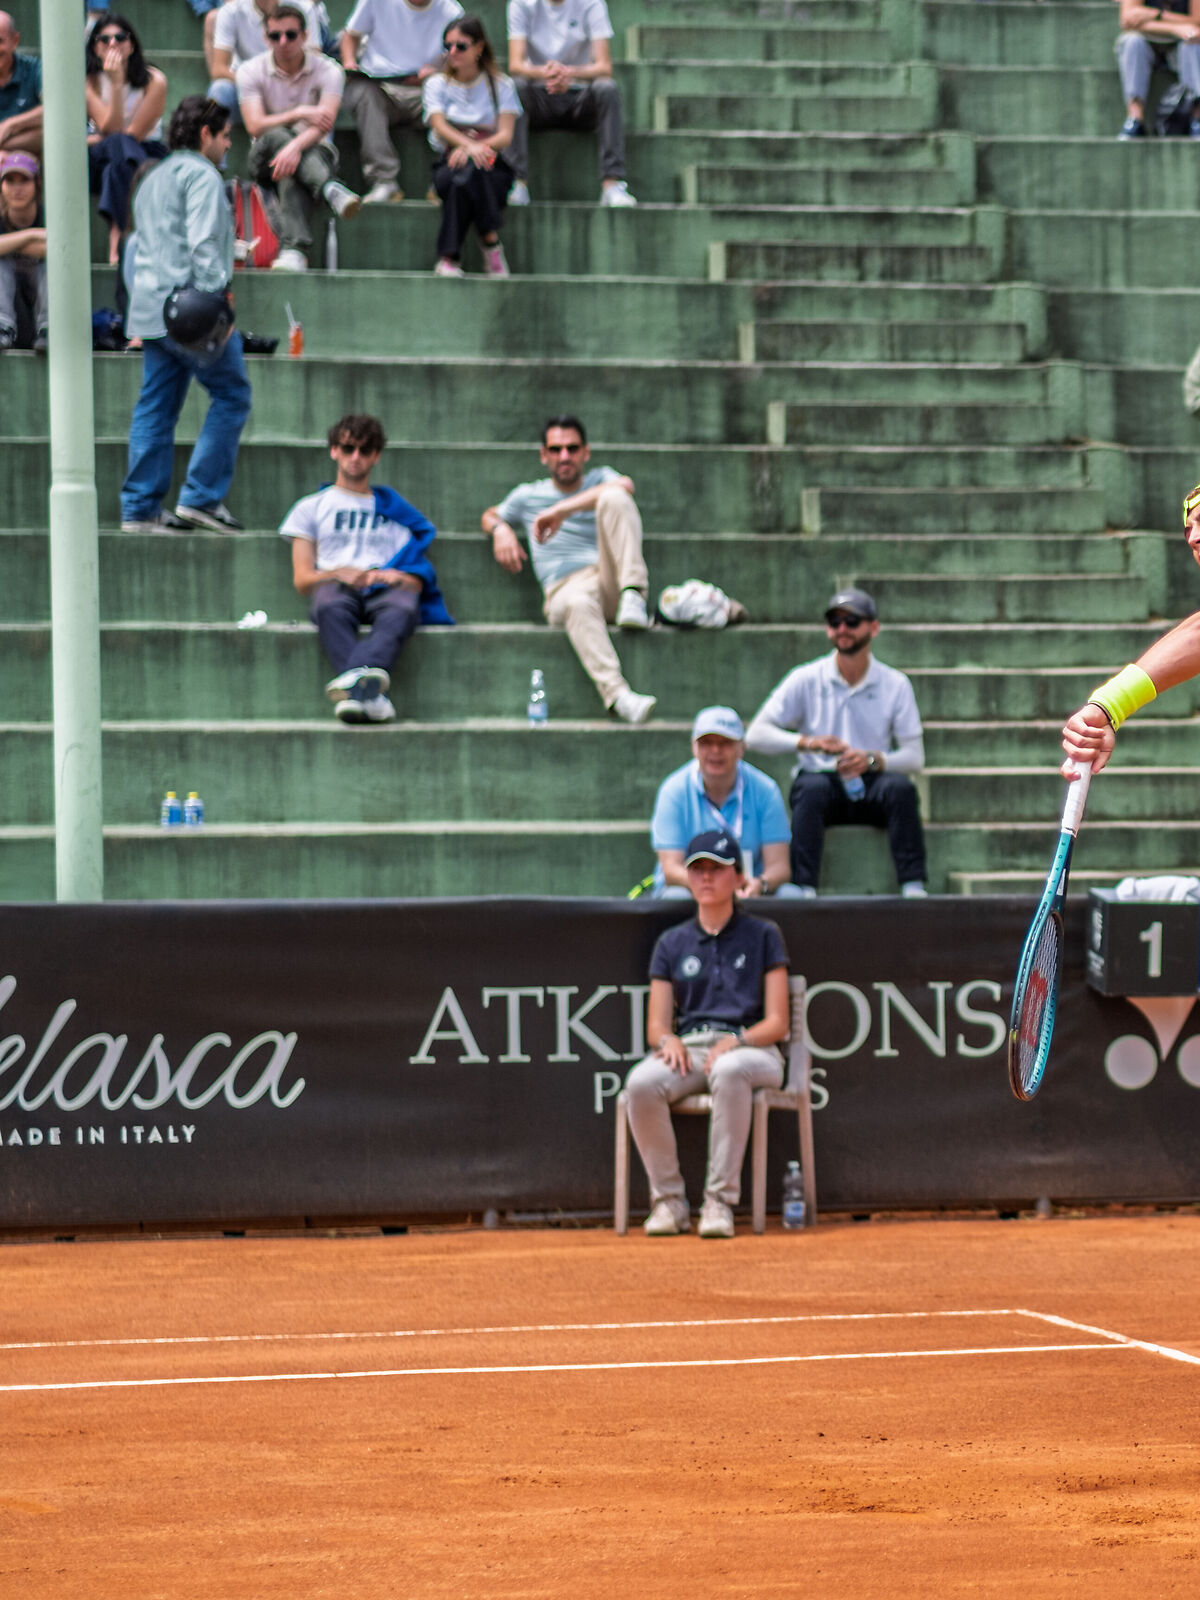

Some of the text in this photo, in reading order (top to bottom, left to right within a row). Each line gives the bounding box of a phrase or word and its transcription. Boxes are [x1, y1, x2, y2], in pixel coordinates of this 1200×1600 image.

[1139, 921, 1163, 978] 1
[0, 974, 306, 1112] elasca
[409, 979, 1008, 1065] ATKIONS
[77, 1126, 105, 1145] IN
[121, 1124, 196, 1144] ITALY
